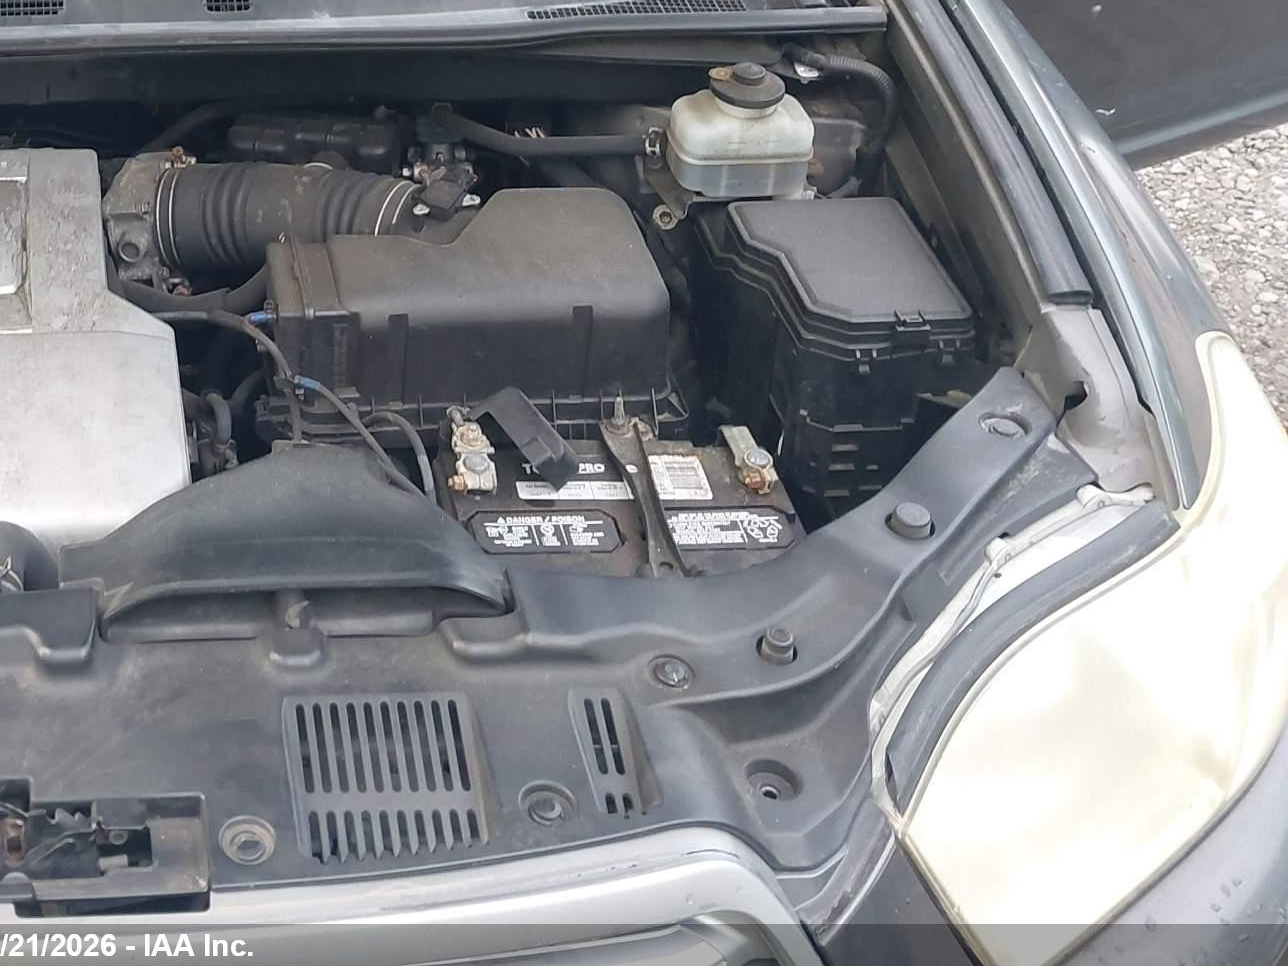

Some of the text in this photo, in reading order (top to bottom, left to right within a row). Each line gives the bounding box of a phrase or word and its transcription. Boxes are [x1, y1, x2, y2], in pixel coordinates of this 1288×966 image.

[578, 462, 606, 475] PRO
[506, 516, 543, 524] DANGER
[551, 515, 585, 523] POISON
